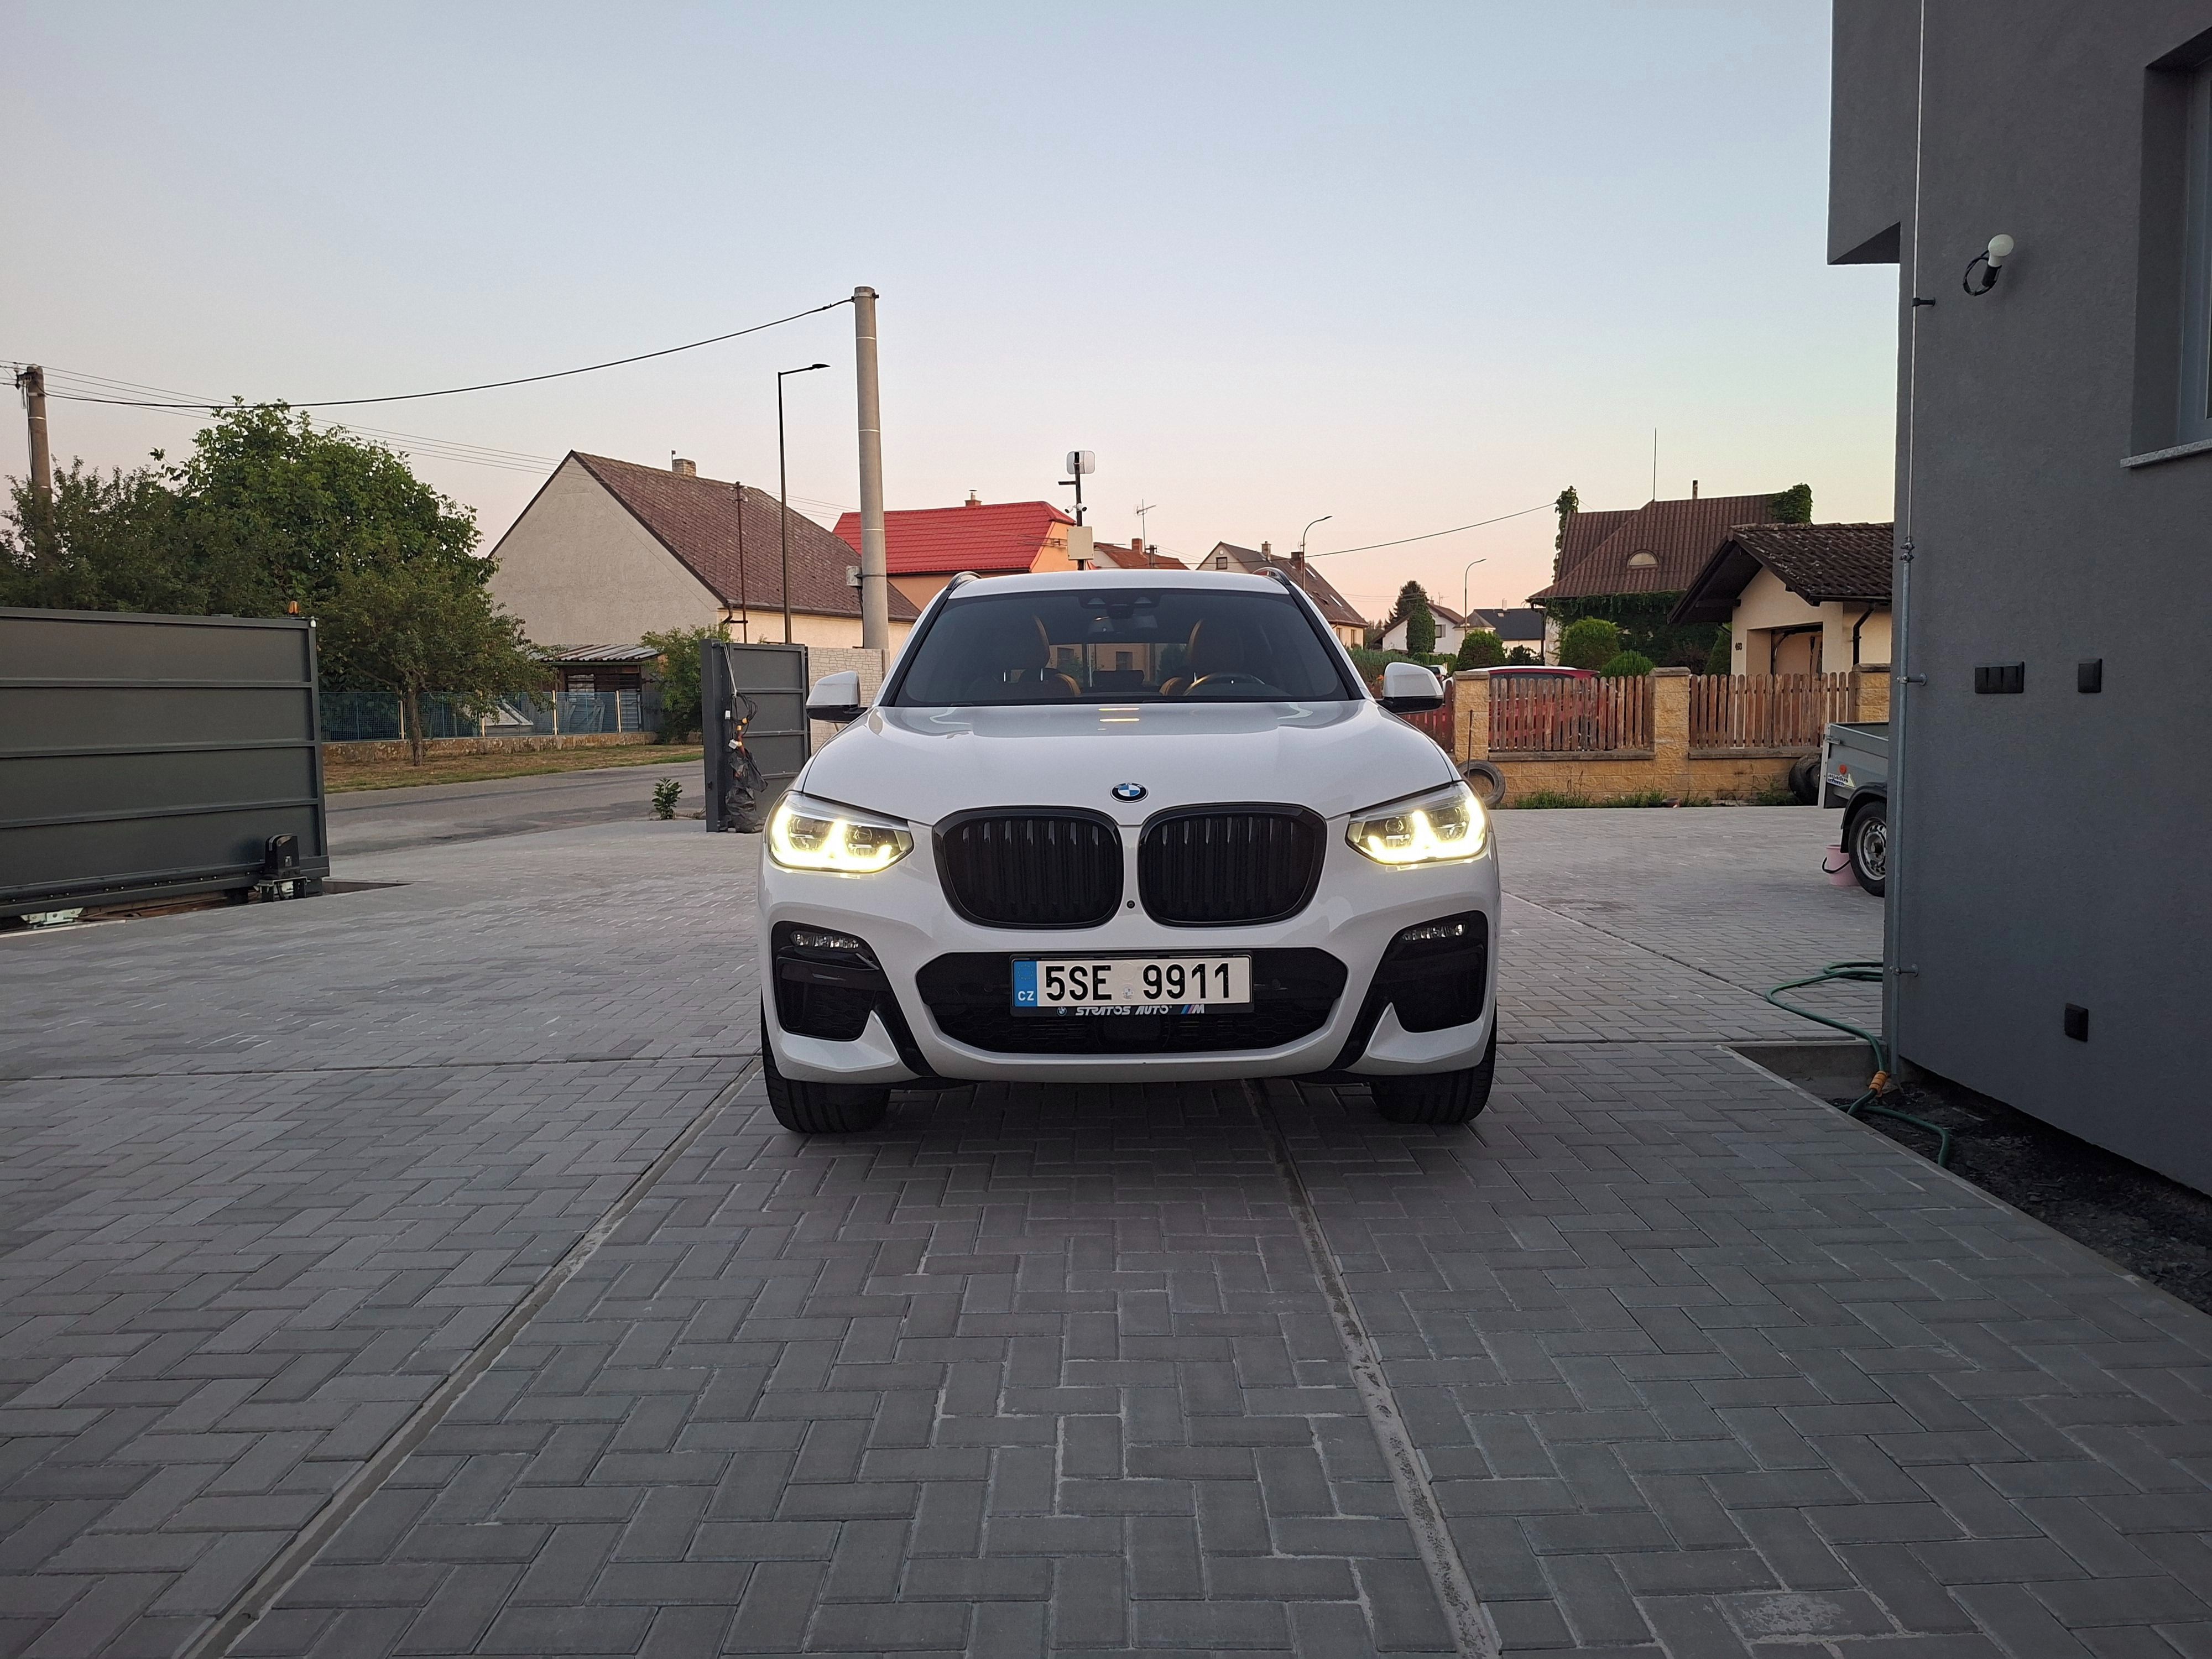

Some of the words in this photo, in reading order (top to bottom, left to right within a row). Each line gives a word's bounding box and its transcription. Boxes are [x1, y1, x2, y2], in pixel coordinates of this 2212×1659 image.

[1046, 965, 1112, 1001] 5SE
[1142, 963, 1229, 999] 9911
[1018, 990, 1035, 1001] CZ
[1075, 1006, 1131, 1016] STRATOS
[1135, 1005, 1169, 1015] AUTO
